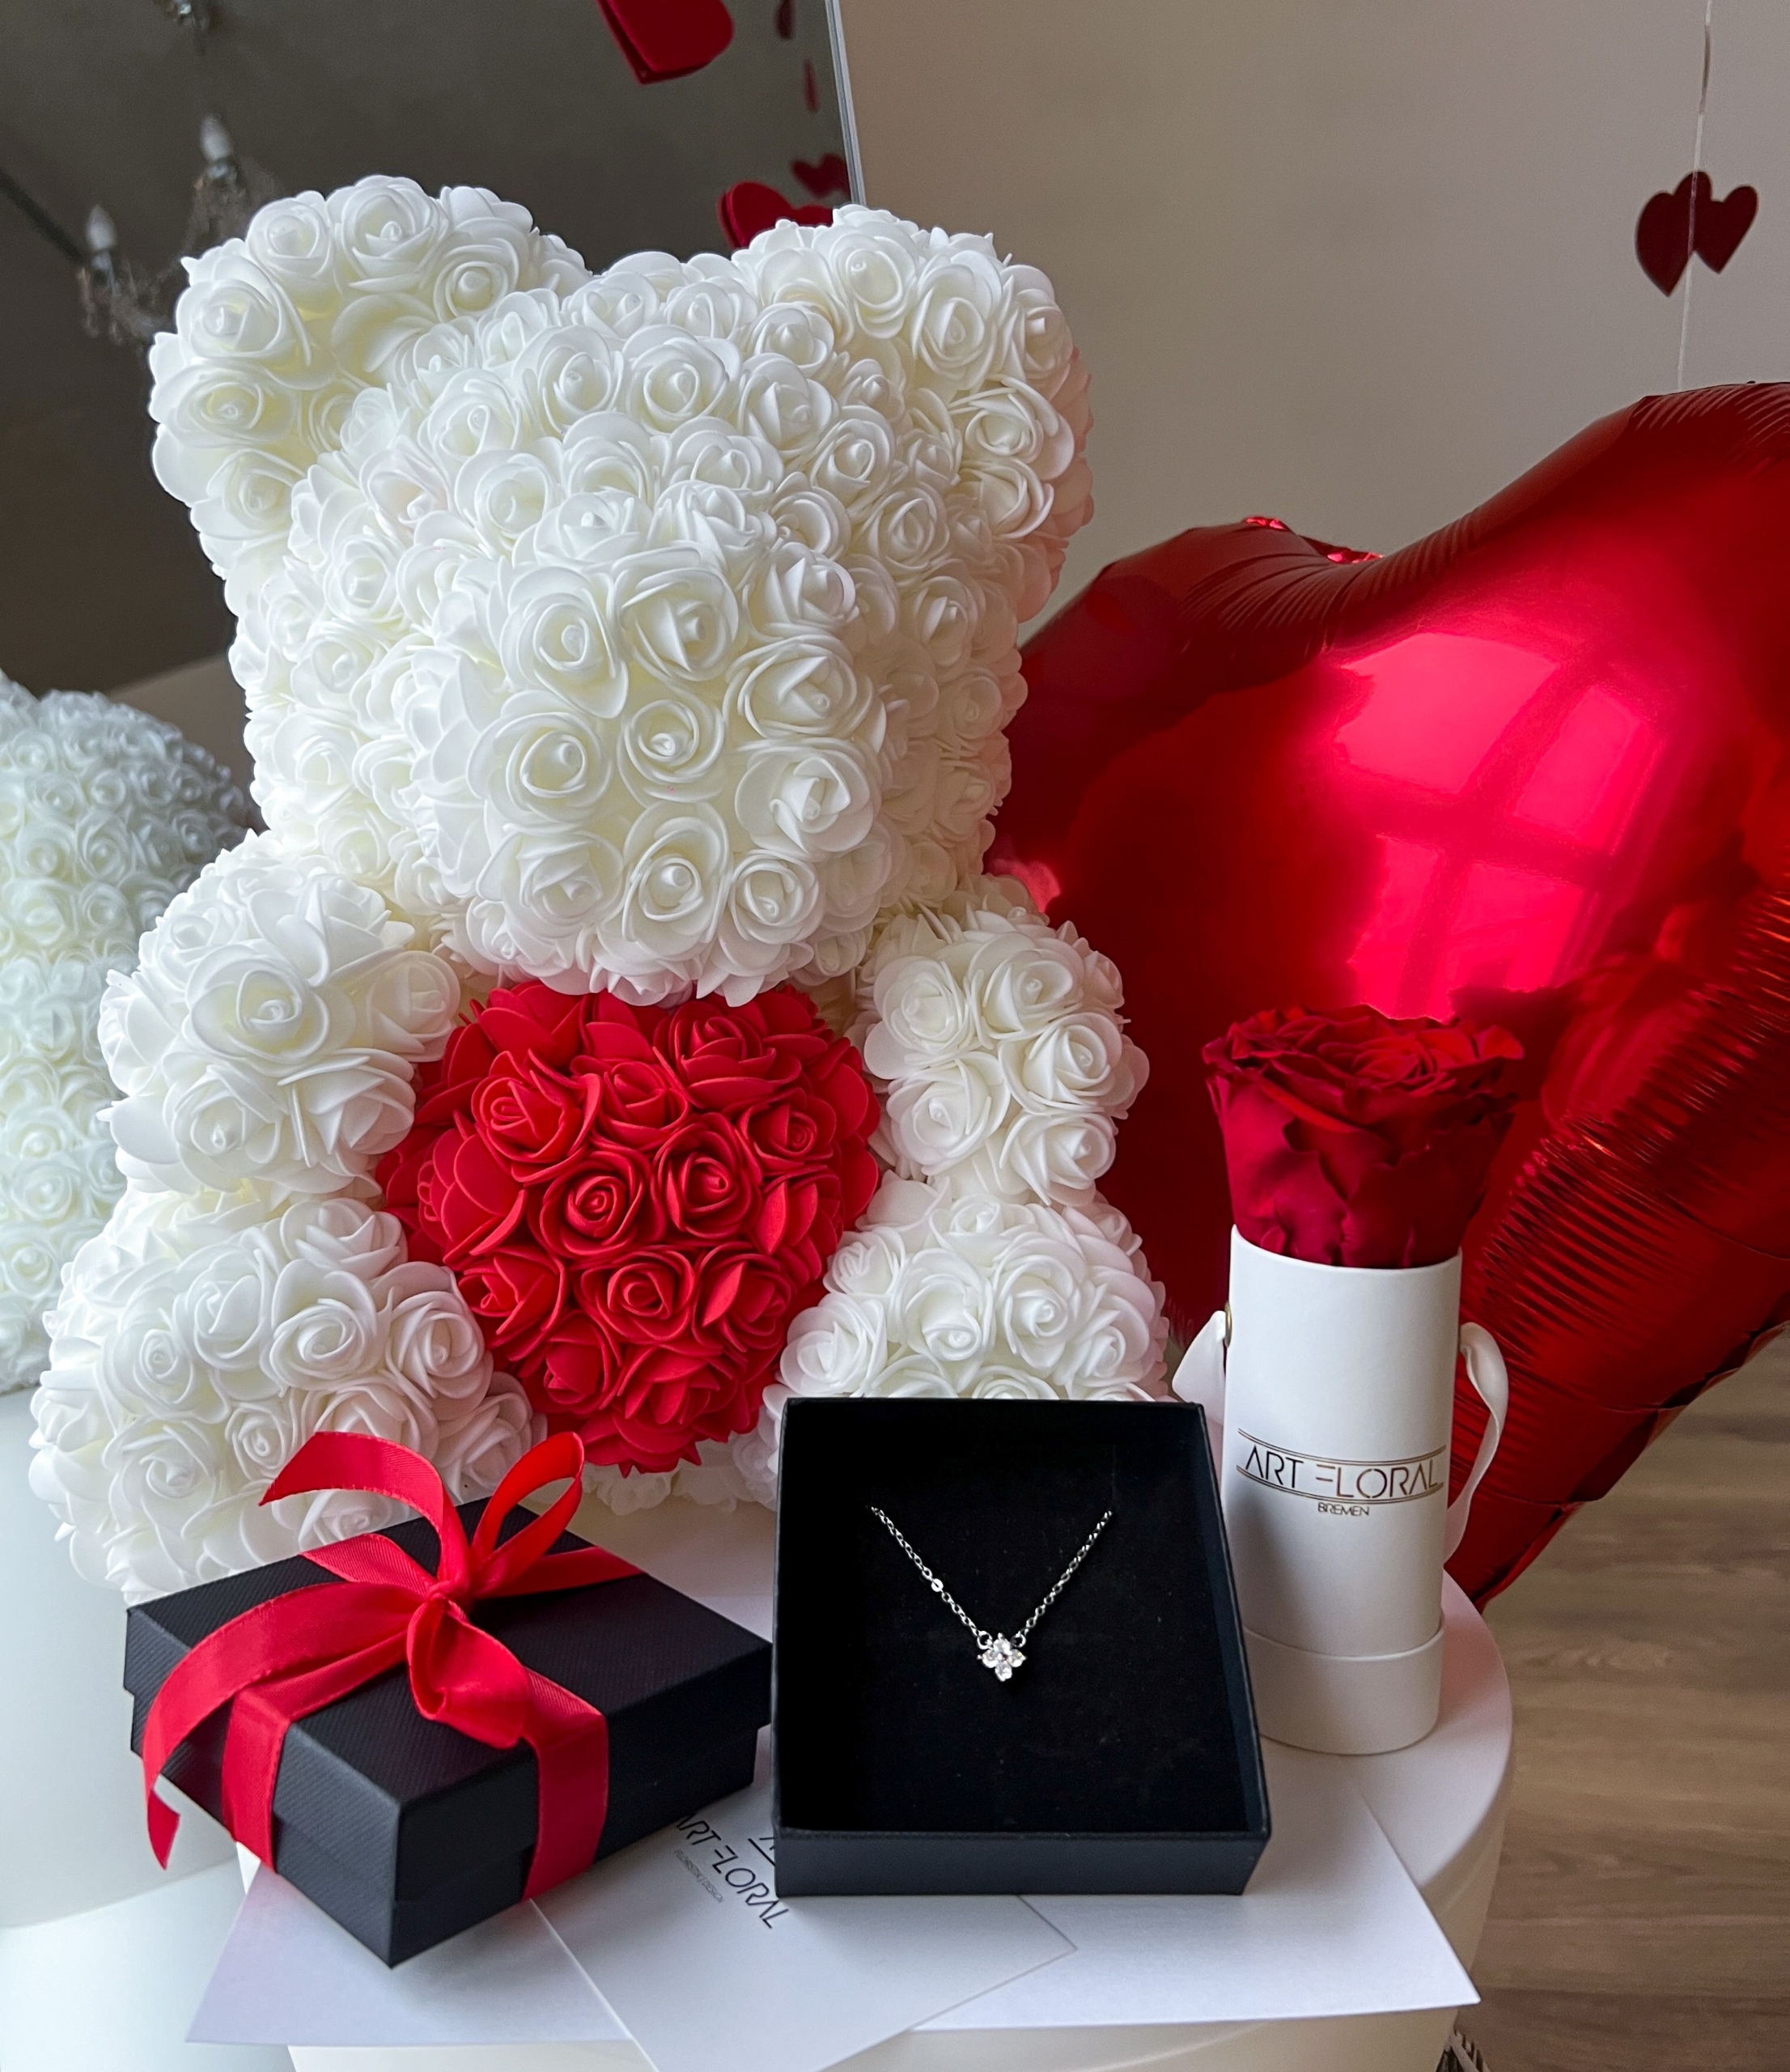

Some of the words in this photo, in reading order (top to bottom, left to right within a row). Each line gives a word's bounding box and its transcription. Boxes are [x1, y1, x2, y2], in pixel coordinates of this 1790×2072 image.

[1245, 1445, 1304, 1488] ART
[1315, 1459, 1438, 1499] FLORAL
[1317, 1502, 1370, 1517] BREMEN
[711, 1845, 790, 1930] FLORAL
